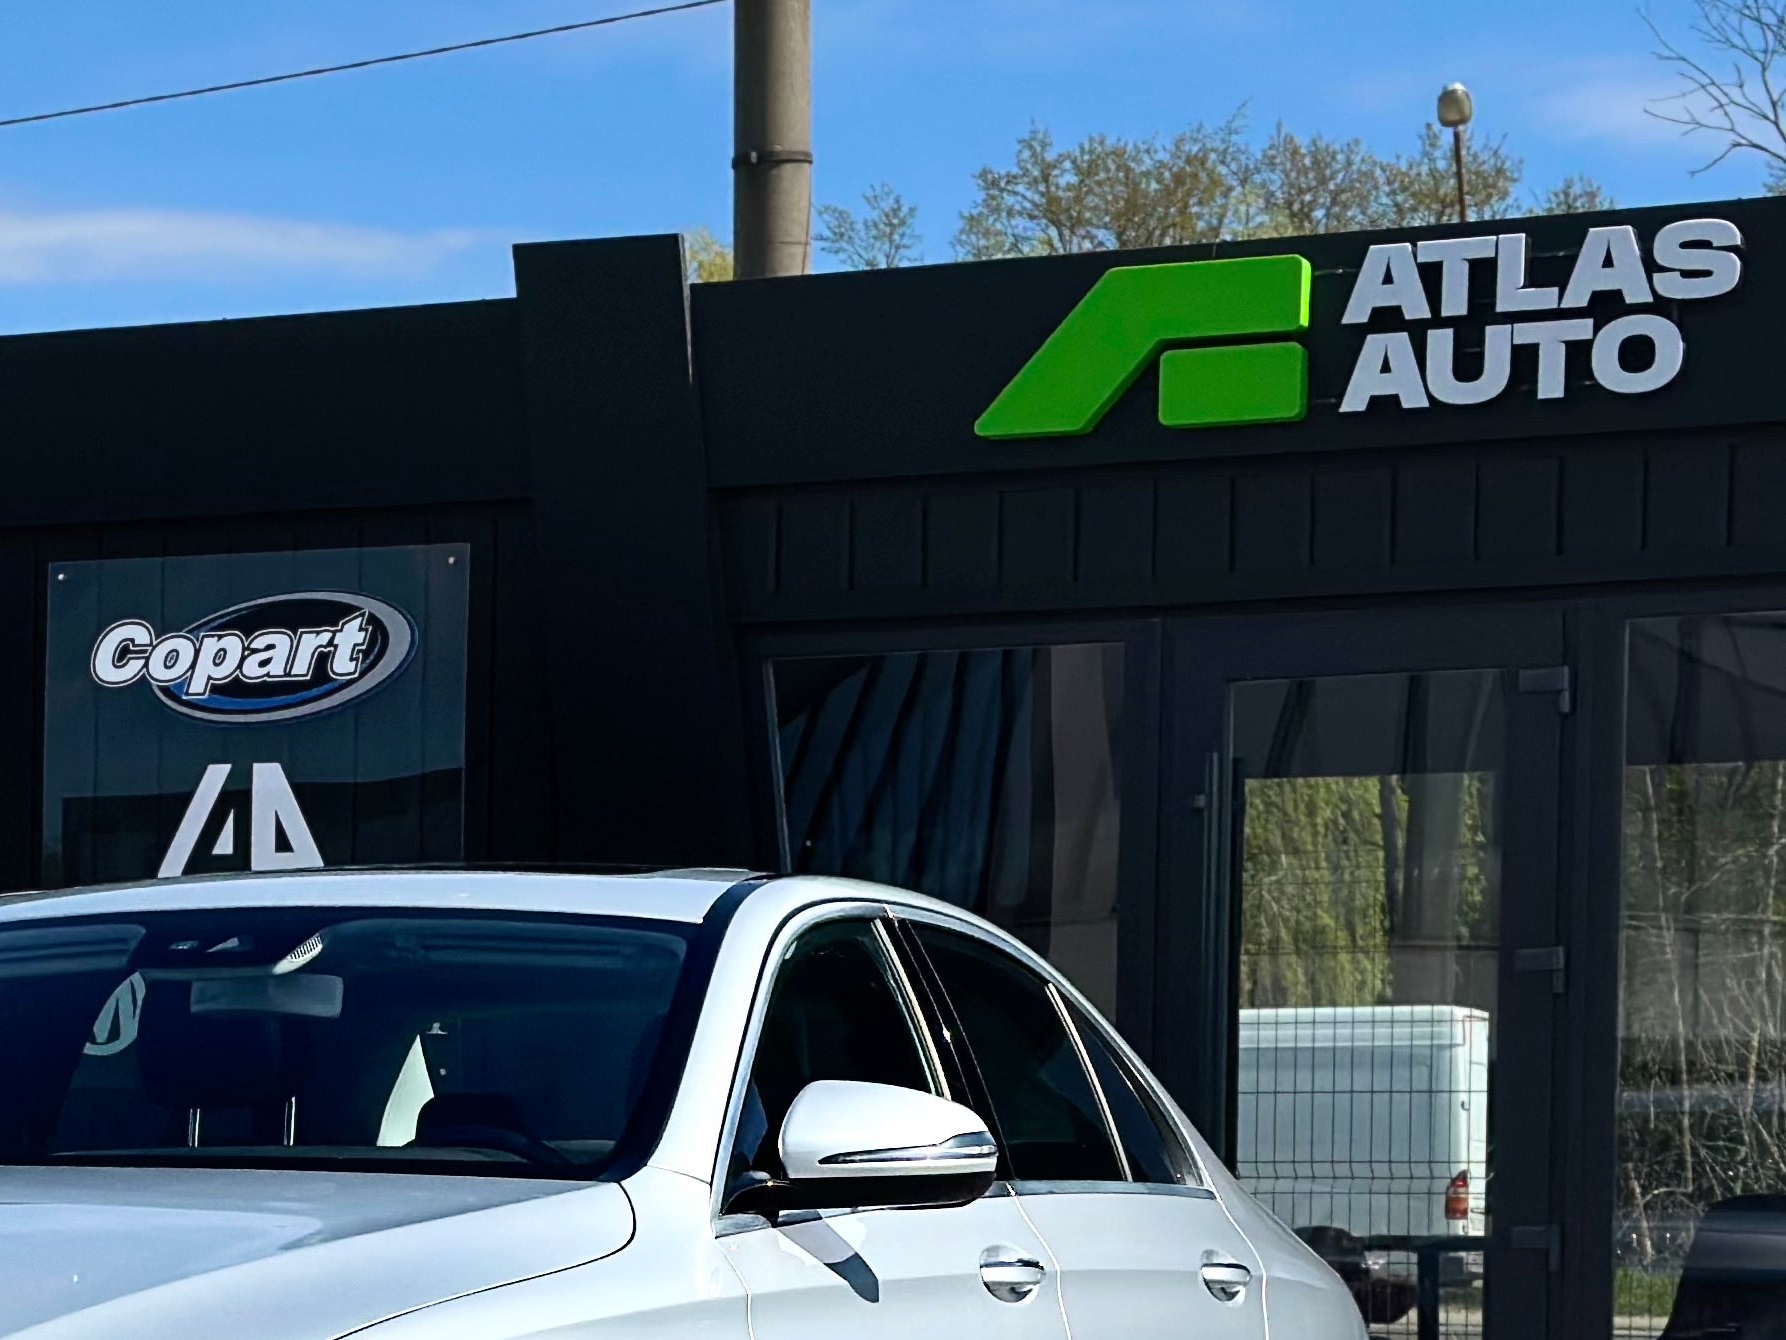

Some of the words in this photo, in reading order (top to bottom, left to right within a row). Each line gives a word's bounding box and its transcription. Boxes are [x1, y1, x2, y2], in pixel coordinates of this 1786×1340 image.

[1342, 218, 1744, 324] ATLAS
[1339, 313, 1685, 413] AUTO
[91, 609, 372, 699] Copart
